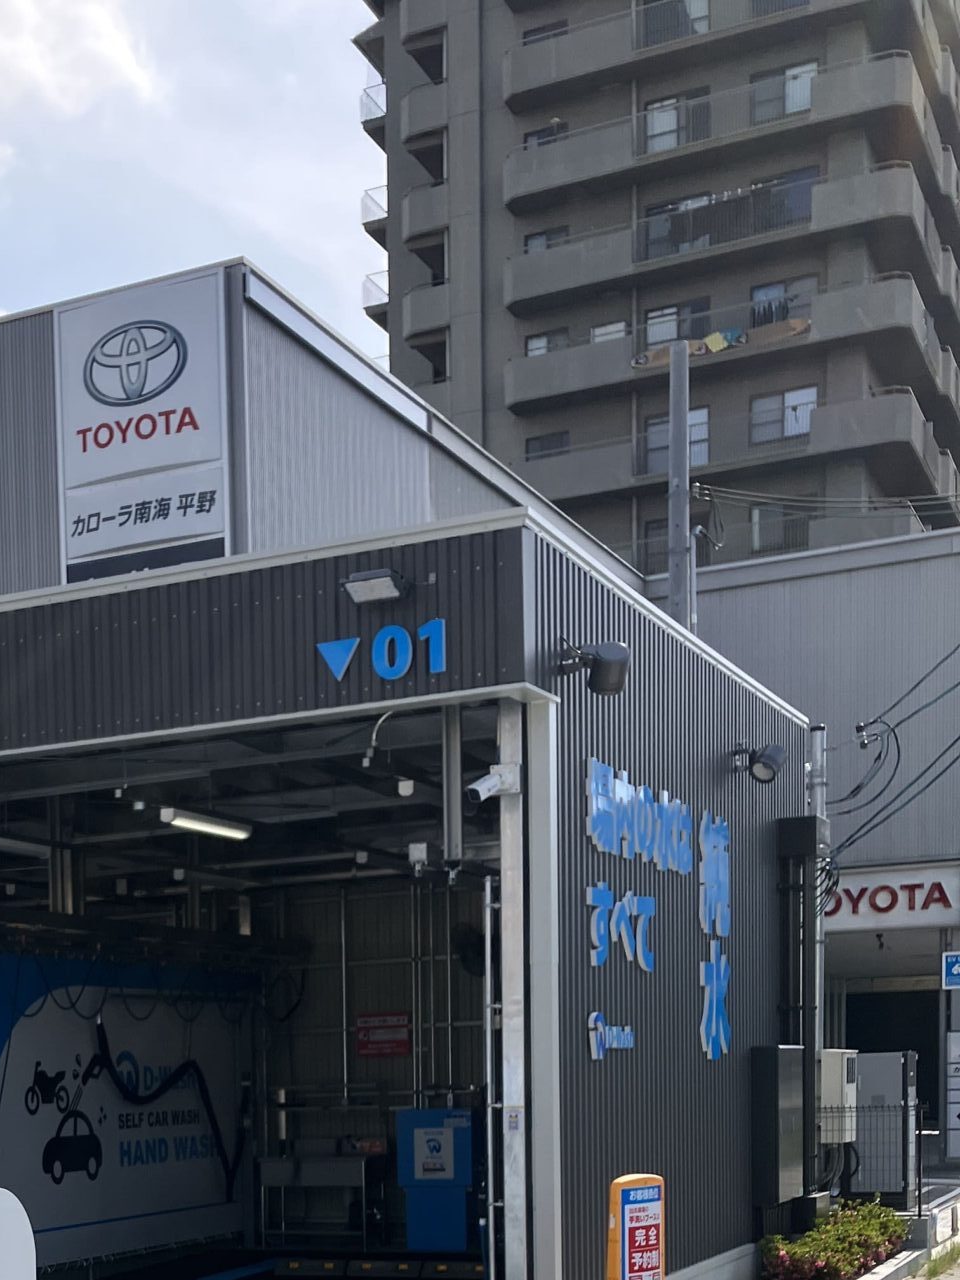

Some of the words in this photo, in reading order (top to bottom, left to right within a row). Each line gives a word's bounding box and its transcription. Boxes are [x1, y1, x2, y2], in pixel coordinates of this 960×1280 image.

[76, 406, 200, 453] TOYOTA
[71, 497, 172, 538] カローラ南海
[176, 490, 217, 518] 平野
[371, 617, 447, 680] 01
[823, 881, 953, 917] OYOTA
[585, 882, 656, 972] すべて
[118, 1112, 144, 1129] SELF
[148, 1111, 169, 1127] CAR
[171, 1109, 200, 1126] WASH
[119, 1137, 169, 1167] HAND
[635, 1226, 658, 1247] 完全
[631, 1249, 659, 1271] 予約制
